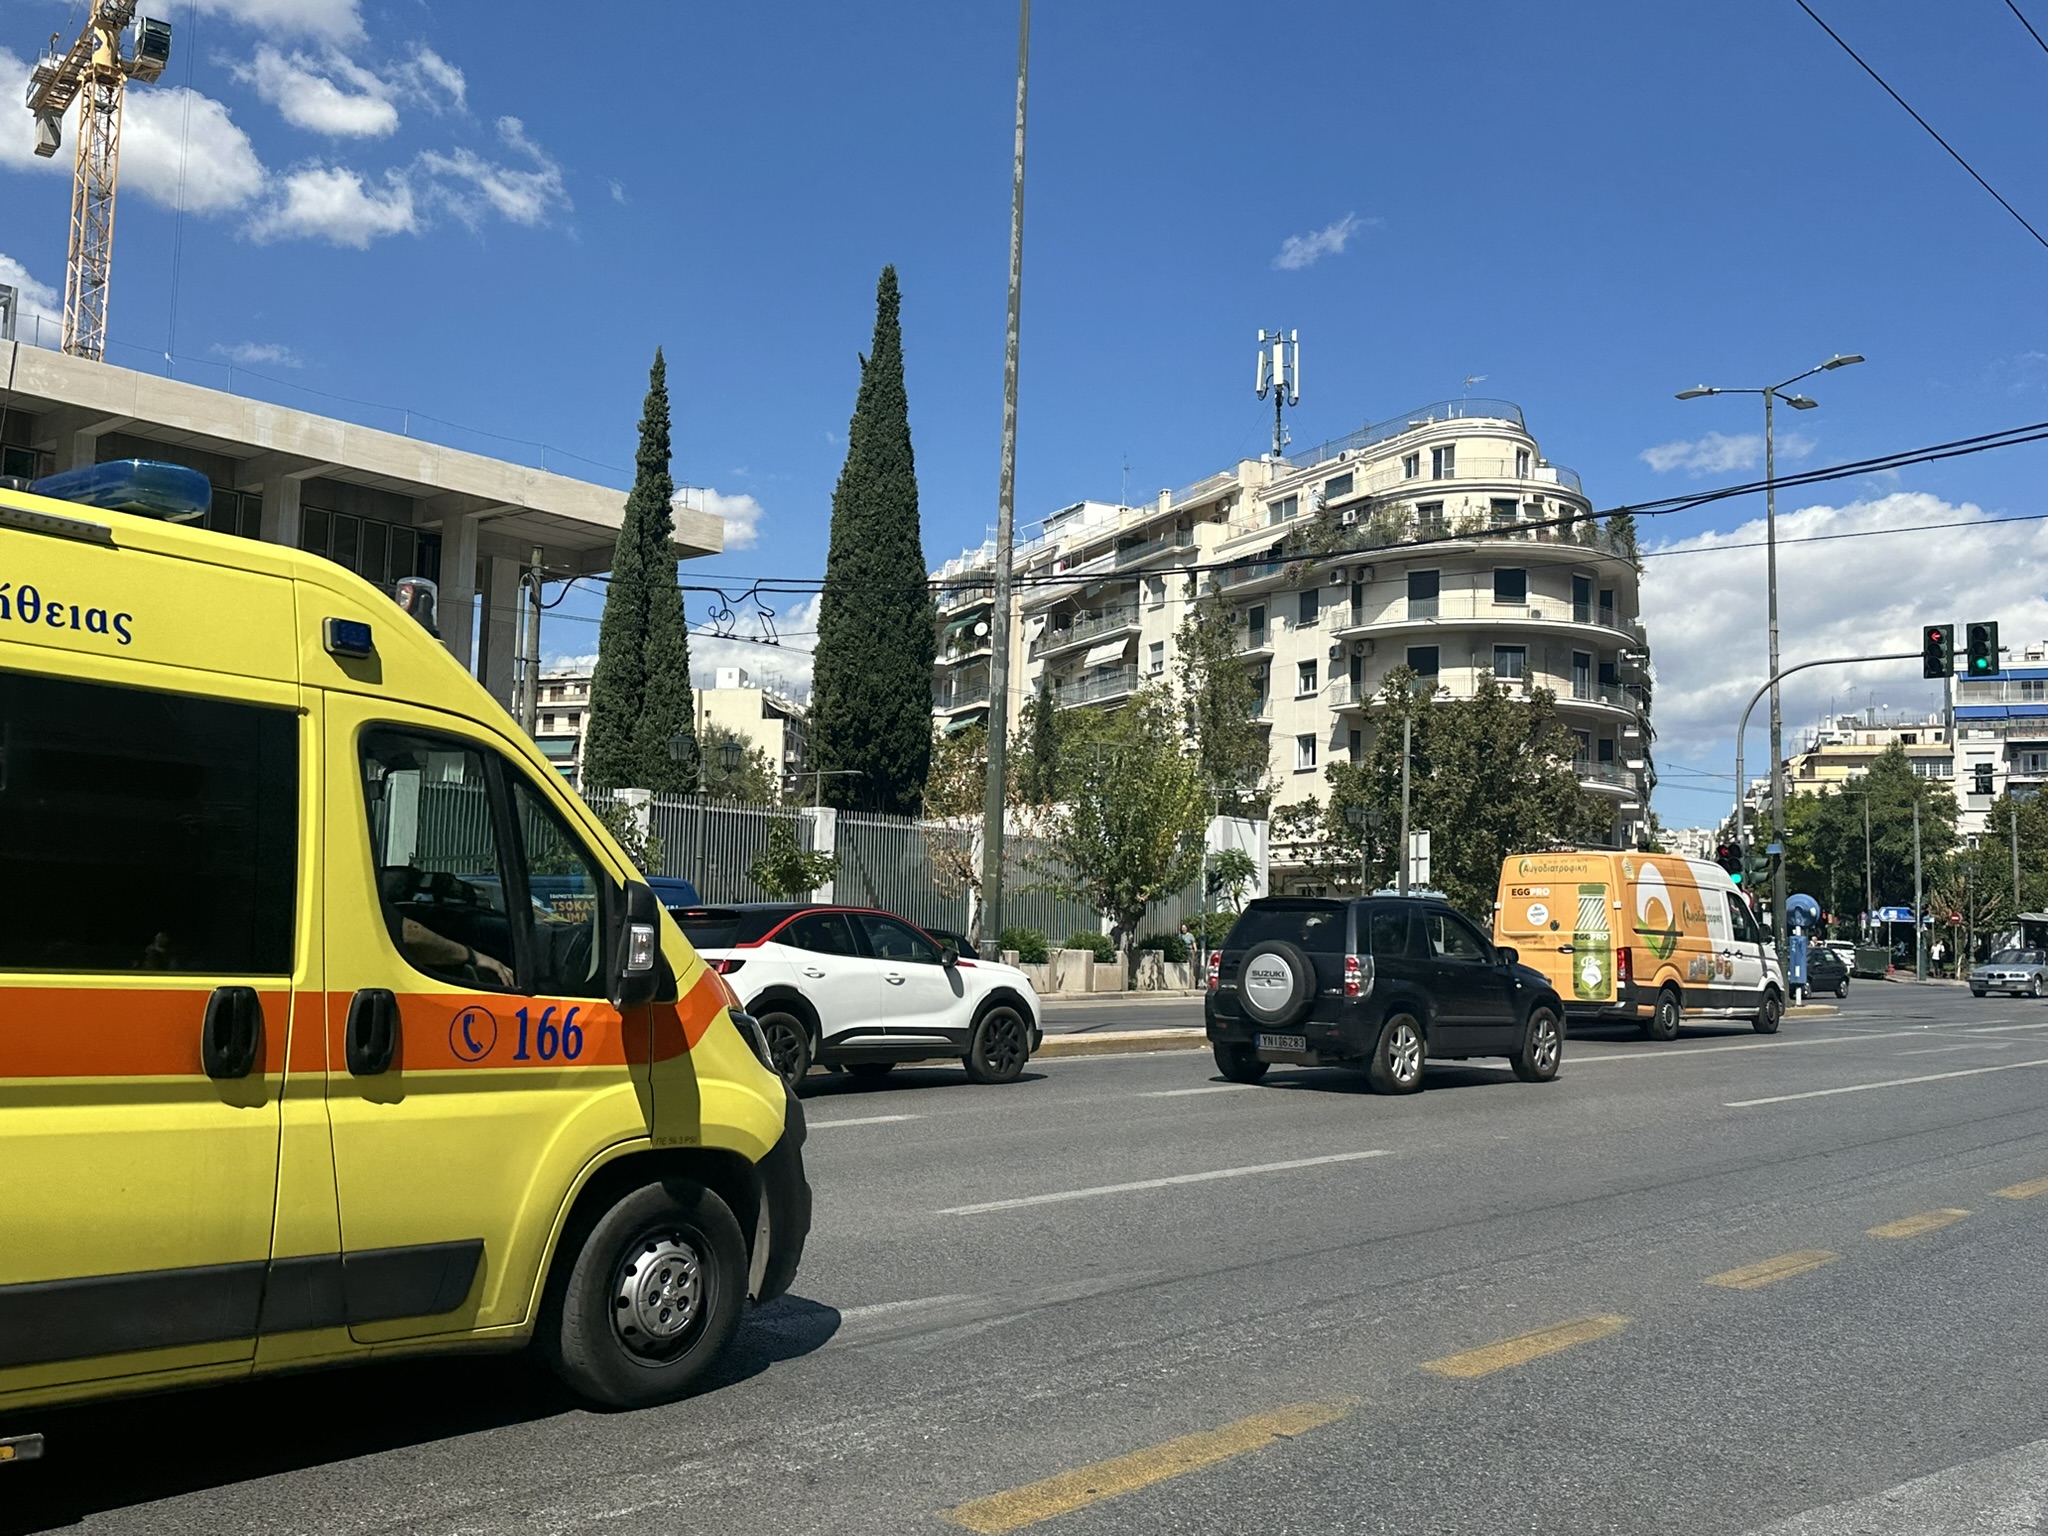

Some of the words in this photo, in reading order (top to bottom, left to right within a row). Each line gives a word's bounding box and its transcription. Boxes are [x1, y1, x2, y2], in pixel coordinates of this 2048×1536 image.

[1511, 887, 1550, 897] EGGPRO
[551, 901, 596, 912] TSOKAS
[1574, 932, 1609, 941] EGGPRO
[512, 1006, 583, 1060] 166
